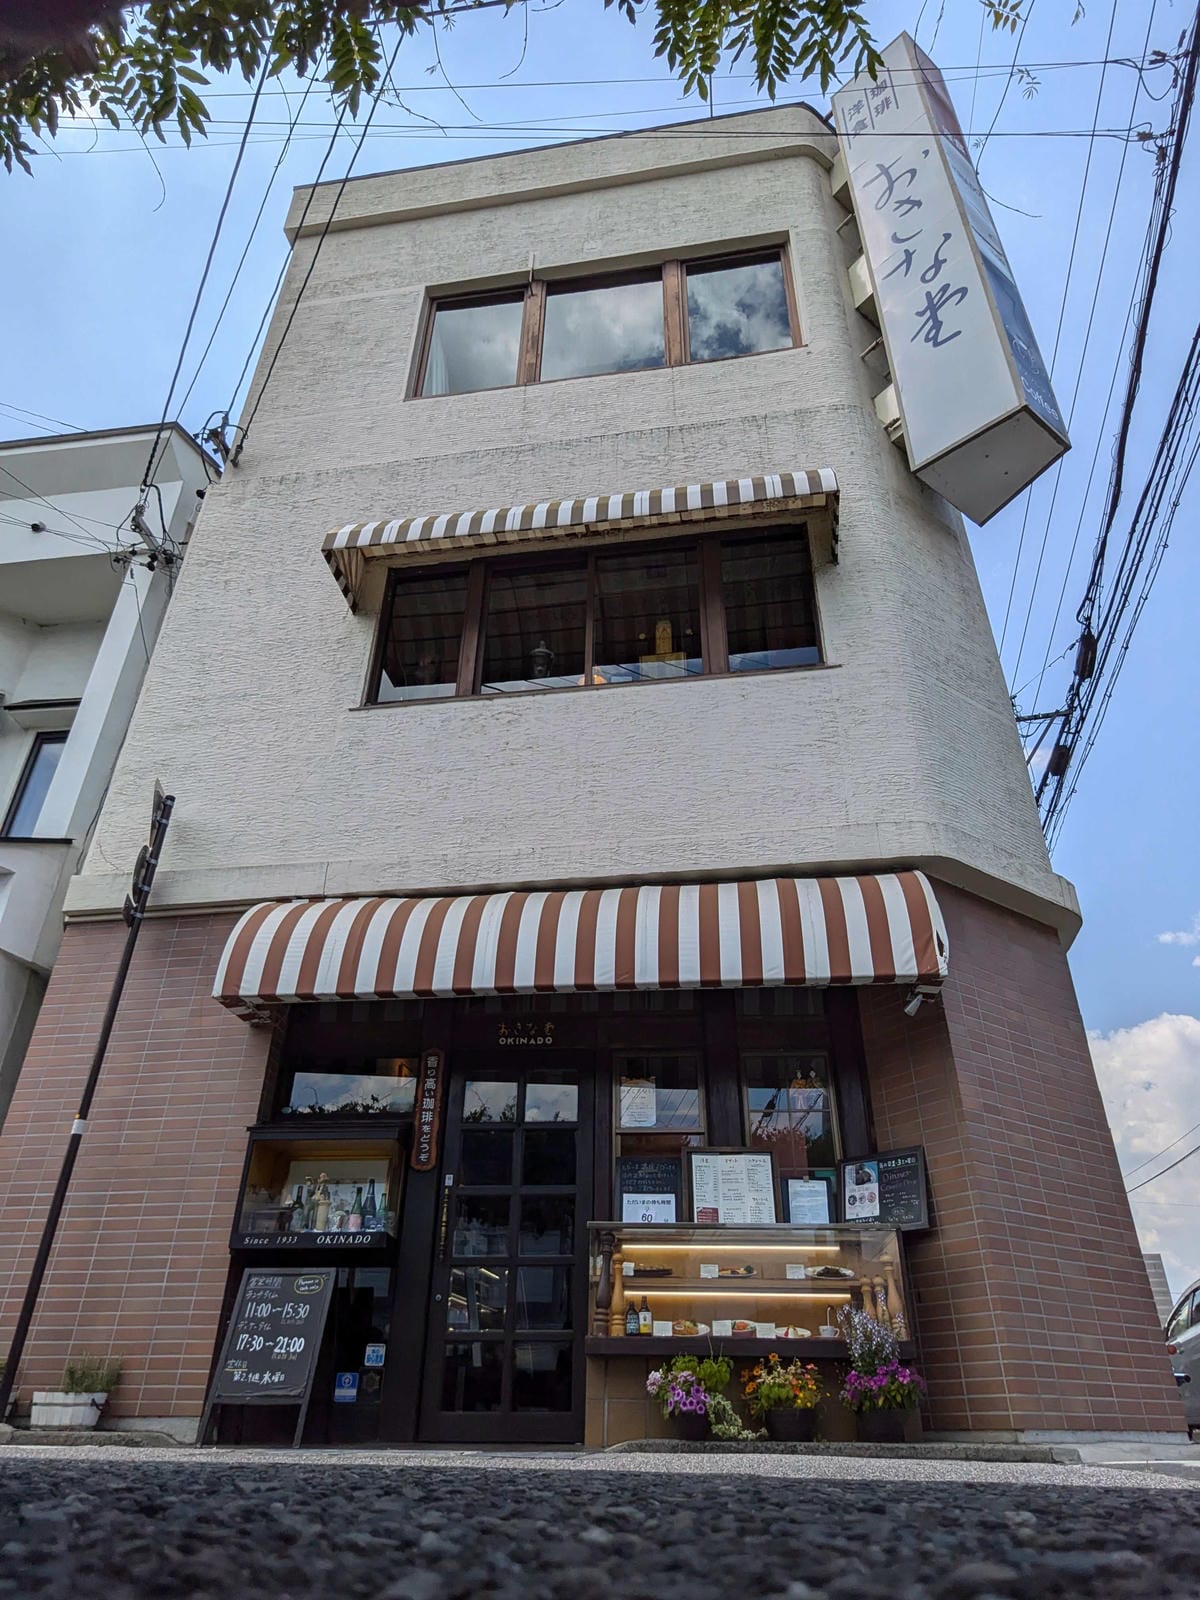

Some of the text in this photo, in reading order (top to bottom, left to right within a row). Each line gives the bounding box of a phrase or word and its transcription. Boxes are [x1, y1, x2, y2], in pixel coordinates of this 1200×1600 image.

[498, 1036, 553, 1046] OKINADO
[419, 1056, 438, 1162] 香り高い珈琲をどうぞ
[641, 1213, 653, 1223] 60
[243, 1236, 270, 1245] Since
[316, 1234, 371, 1244] OKINADO
